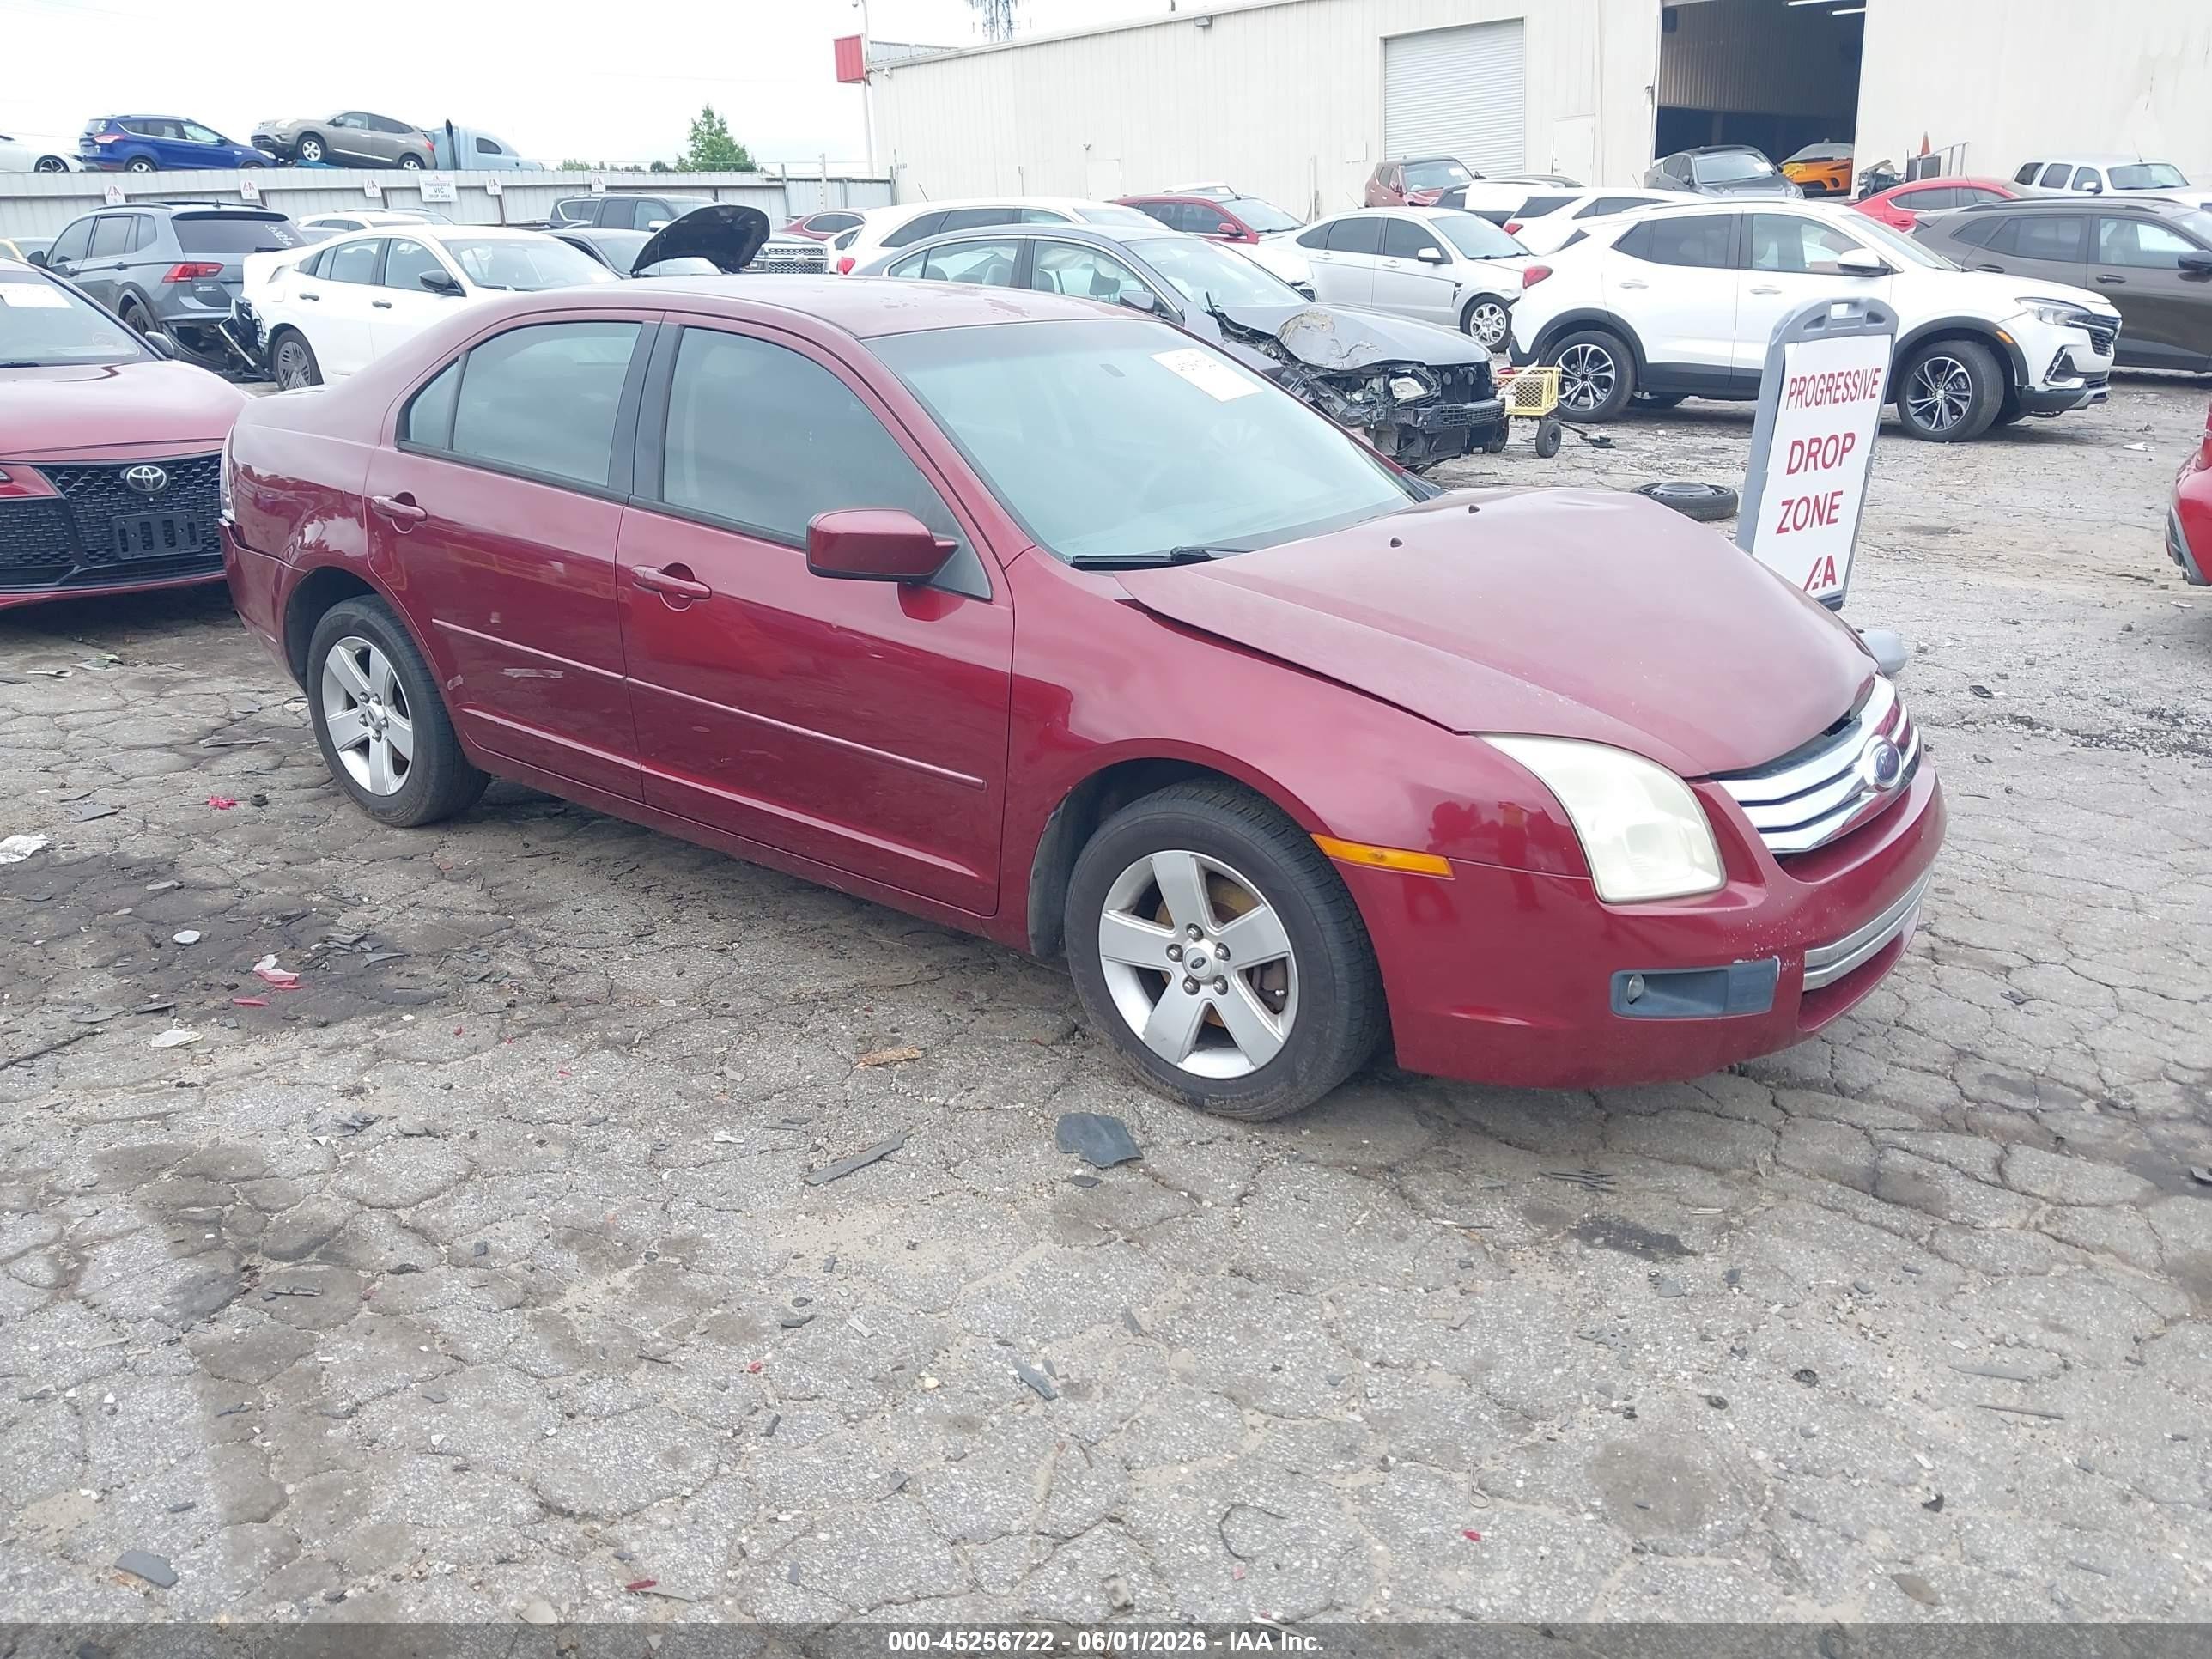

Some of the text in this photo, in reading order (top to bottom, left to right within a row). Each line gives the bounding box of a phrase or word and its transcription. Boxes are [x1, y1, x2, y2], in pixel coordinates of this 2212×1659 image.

[1786, 368, 1881, 410] PROGRESSIVE
[1786, 433, 1856, 475] DROP
[1776, 490, 1844, 534] ZONE
